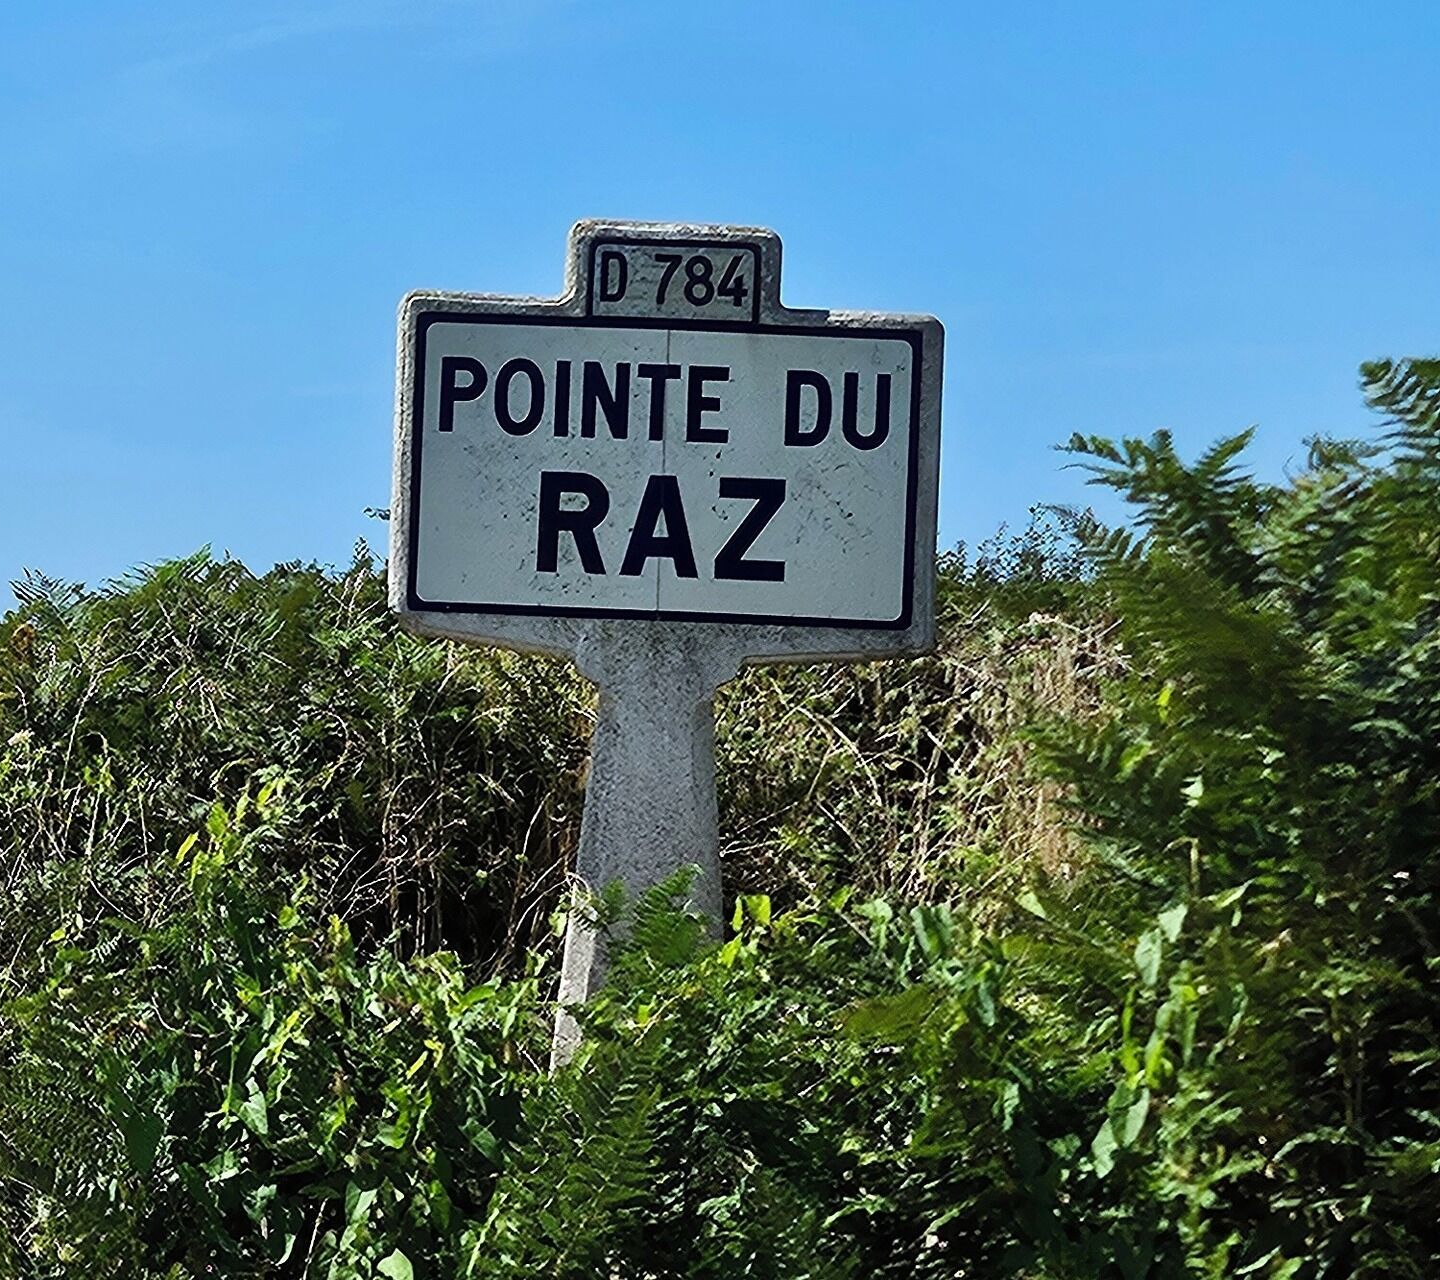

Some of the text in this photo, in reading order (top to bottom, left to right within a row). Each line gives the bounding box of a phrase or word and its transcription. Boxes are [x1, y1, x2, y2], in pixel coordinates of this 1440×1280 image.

[599, 250, 749, 308] D 784
[438, 355, 892, 451] POINTE DU
[535, 470, 787, 582] RAZ
